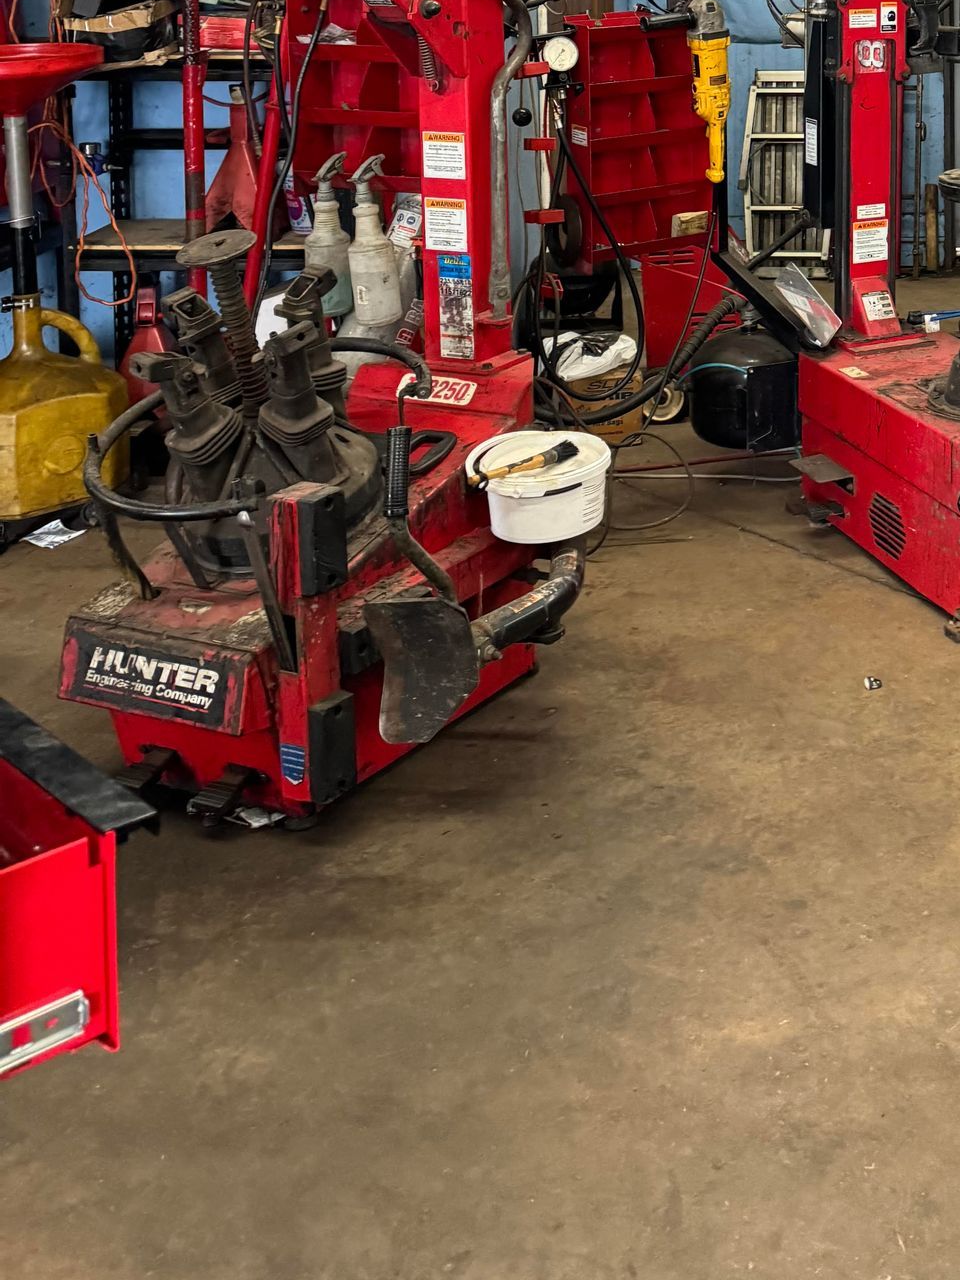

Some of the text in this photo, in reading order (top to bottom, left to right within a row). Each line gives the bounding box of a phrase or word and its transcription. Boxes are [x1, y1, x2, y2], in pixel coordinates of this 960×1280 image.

[436, 200, 462, 208] WARNING
[862, 221, 886, 229] WARNING
[89, 646, 220, 694] HUNTER
[85, 670, 213, 709] Engineering Company
